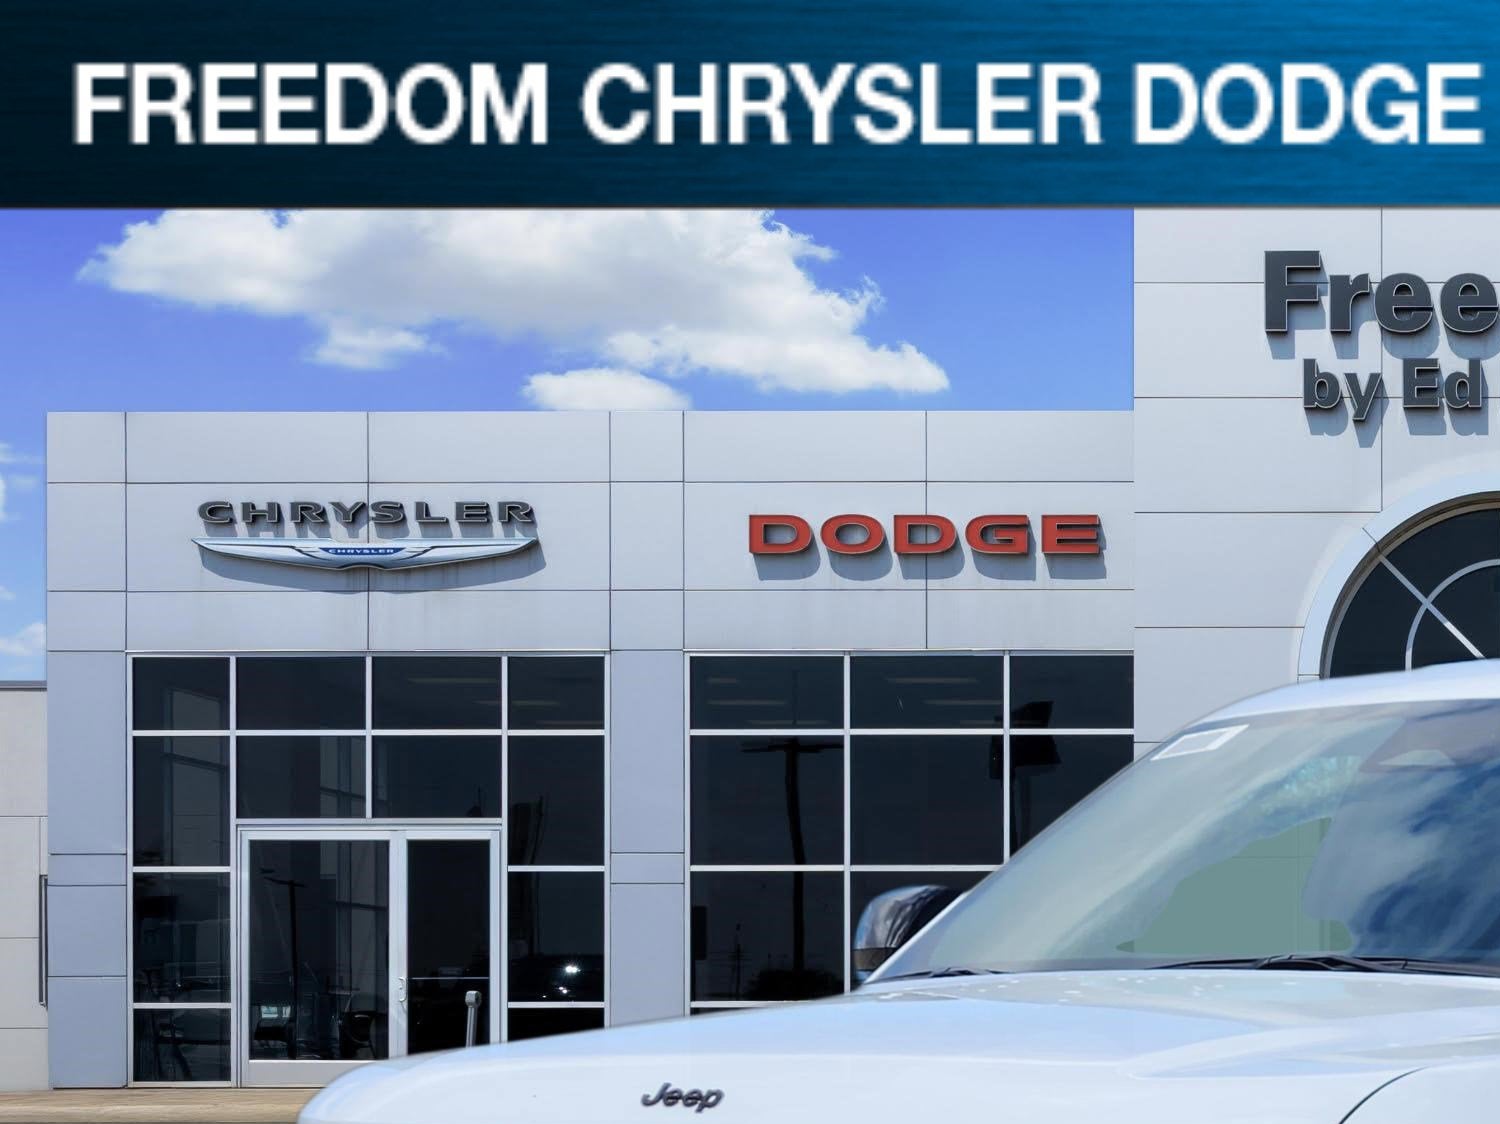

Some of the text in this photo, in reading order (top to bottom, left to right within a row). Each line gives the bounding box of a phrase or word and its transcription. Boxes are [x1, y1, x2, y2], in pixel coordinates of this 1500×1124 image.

[1302, 357, 1383, 421] by
[1401, 357, 1483, 410] Ed
[197, 499, 536, 524] CHRYSLER
[748, 513, 1101, 555] DODGE
[640, 1081, 726, 1114] Jeep
